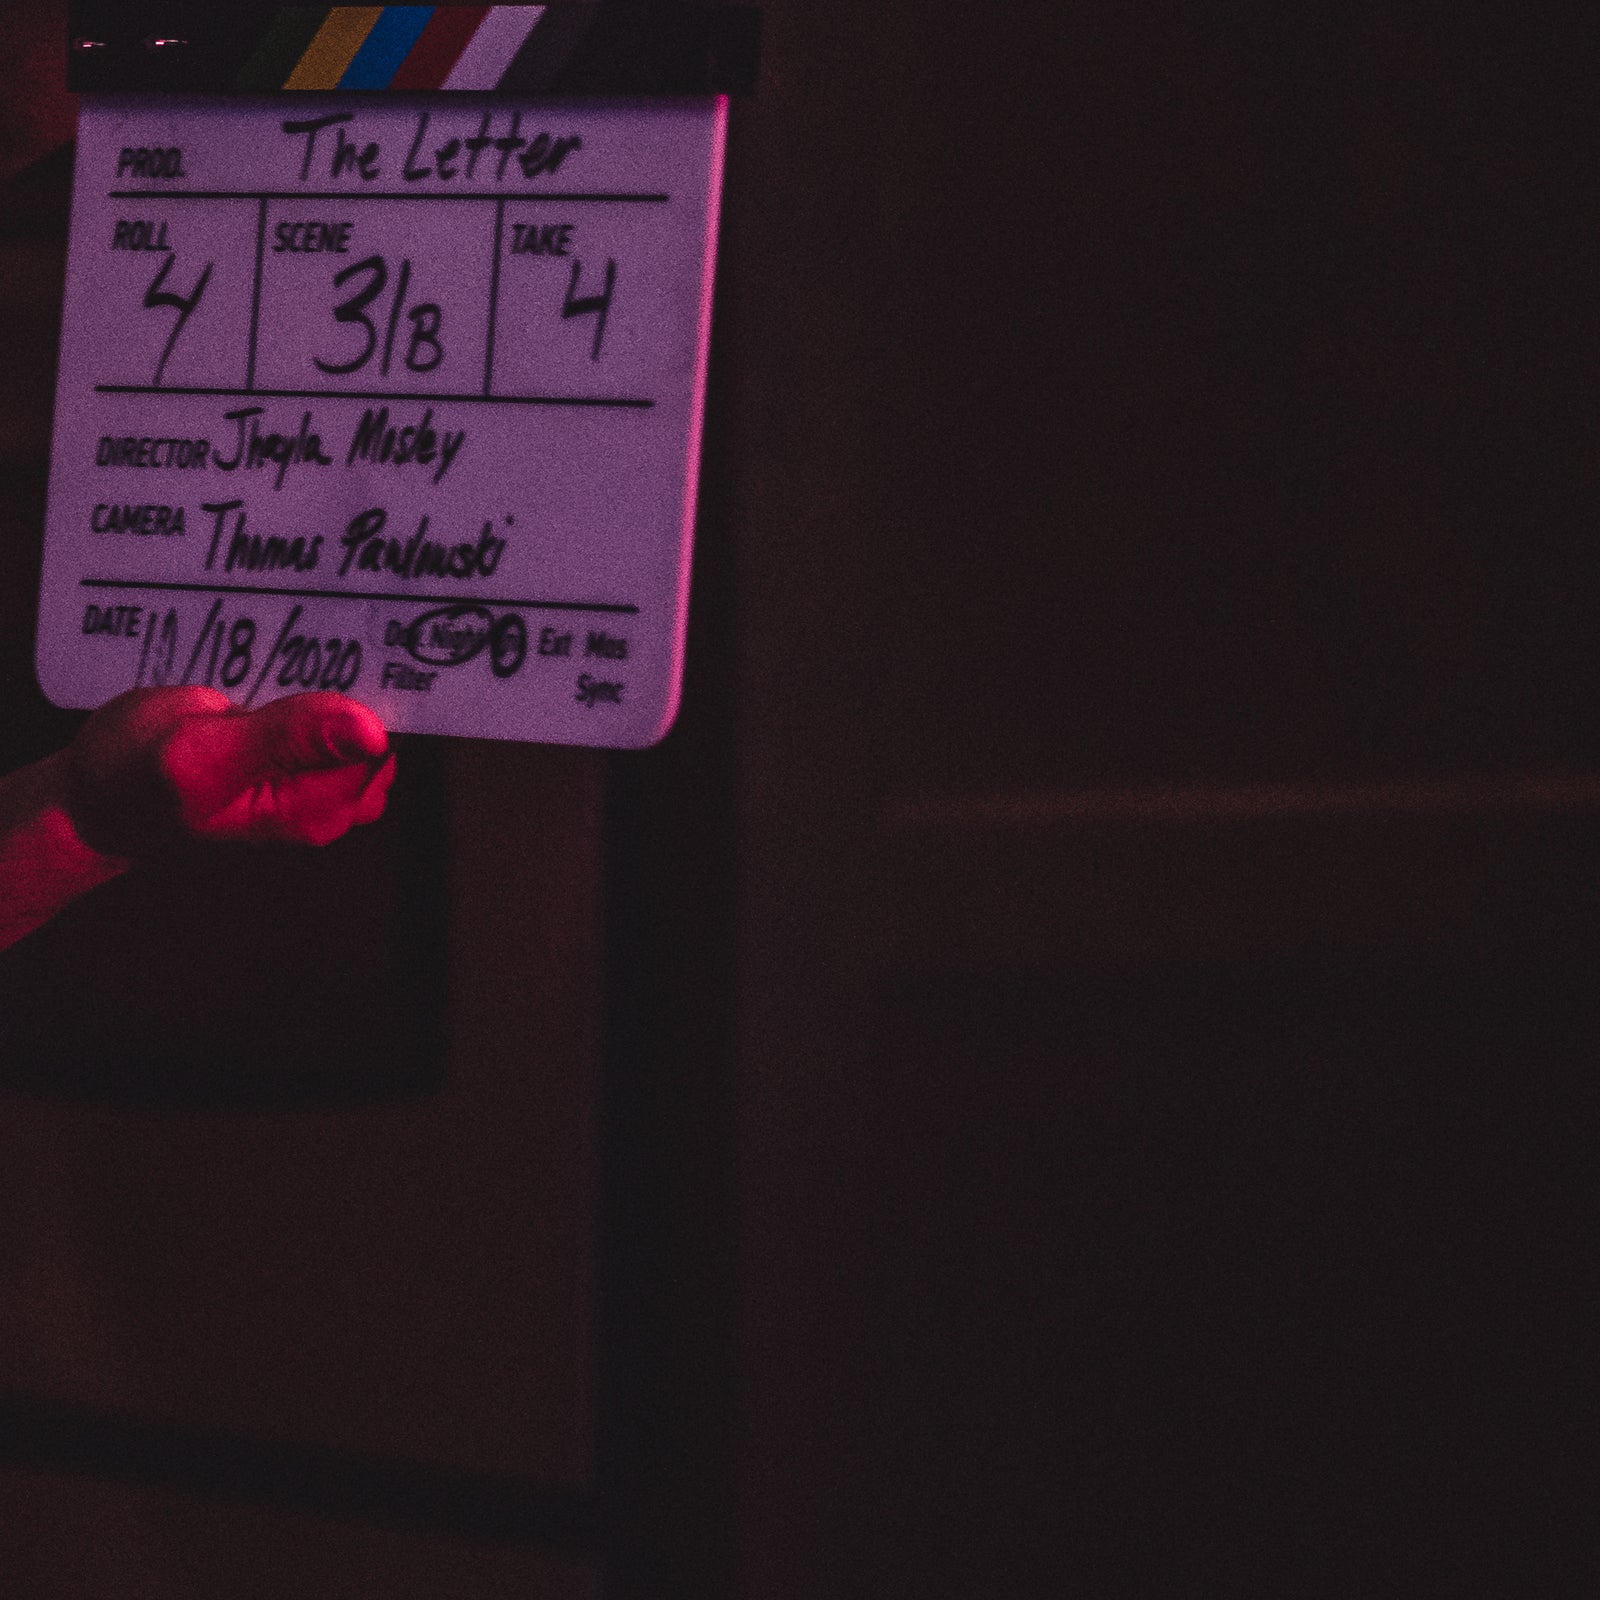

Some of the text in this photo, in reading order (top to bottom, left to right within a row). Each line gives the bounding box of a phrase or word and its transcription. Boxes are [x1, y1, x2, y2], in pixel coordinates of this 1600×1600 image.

[282, 112, 582, 181] The Letter
[112, 219, 173, 251] ROLL
[273, 221, 354, 253] SCENE
[510, 222, 573, 256] TAKE
[143, 254, 212, 387] 4
[562, 257, 616, 363] 4
[95, 435, 210, 468] DIRECTOR
[90, 502, 186, 536] CAMERA
[200, 499, 324, 573] Thomas
[82, 604, 141, 638] DATE
[538, 626, 574, 657] Ext
[381, 662, 438, 693] Filter
[574, 672, 625, 709] Sync
